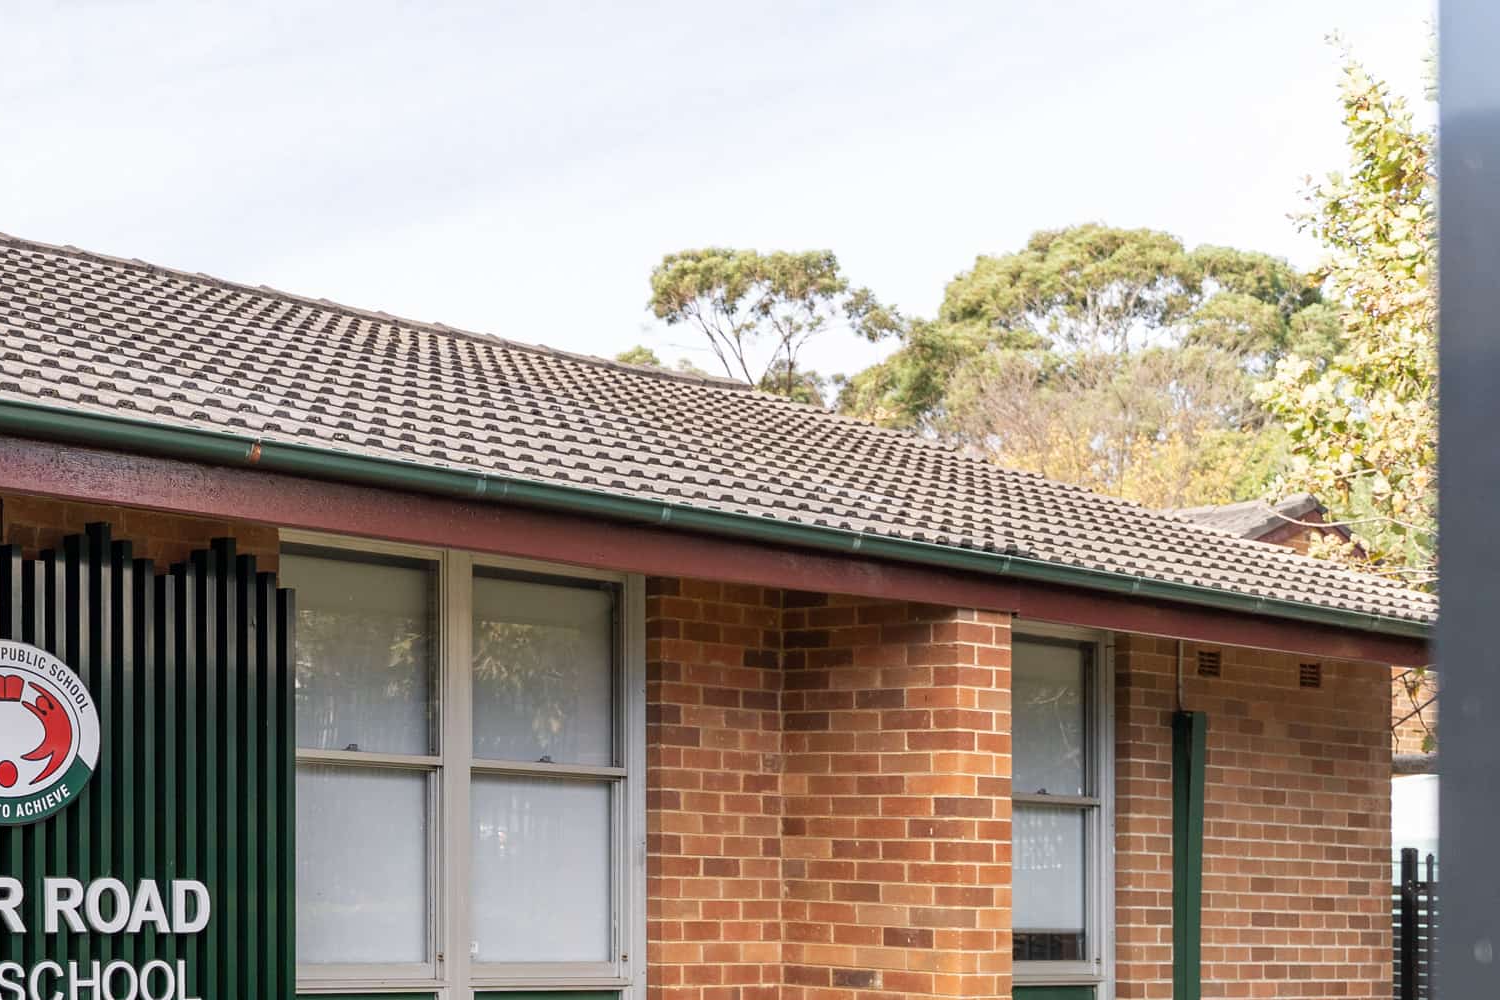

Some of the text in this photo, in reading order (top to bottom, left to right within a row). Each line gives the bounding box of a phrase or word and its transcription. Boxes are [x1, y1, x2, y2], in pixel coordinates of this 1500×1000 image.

[0, 647, 46, 669] PUBLIC
[49, 663, 89, 714] SCHOOL
[16, 783, 71, 816] ACHIEVE
[43, 876, 212, 934] ROAD
